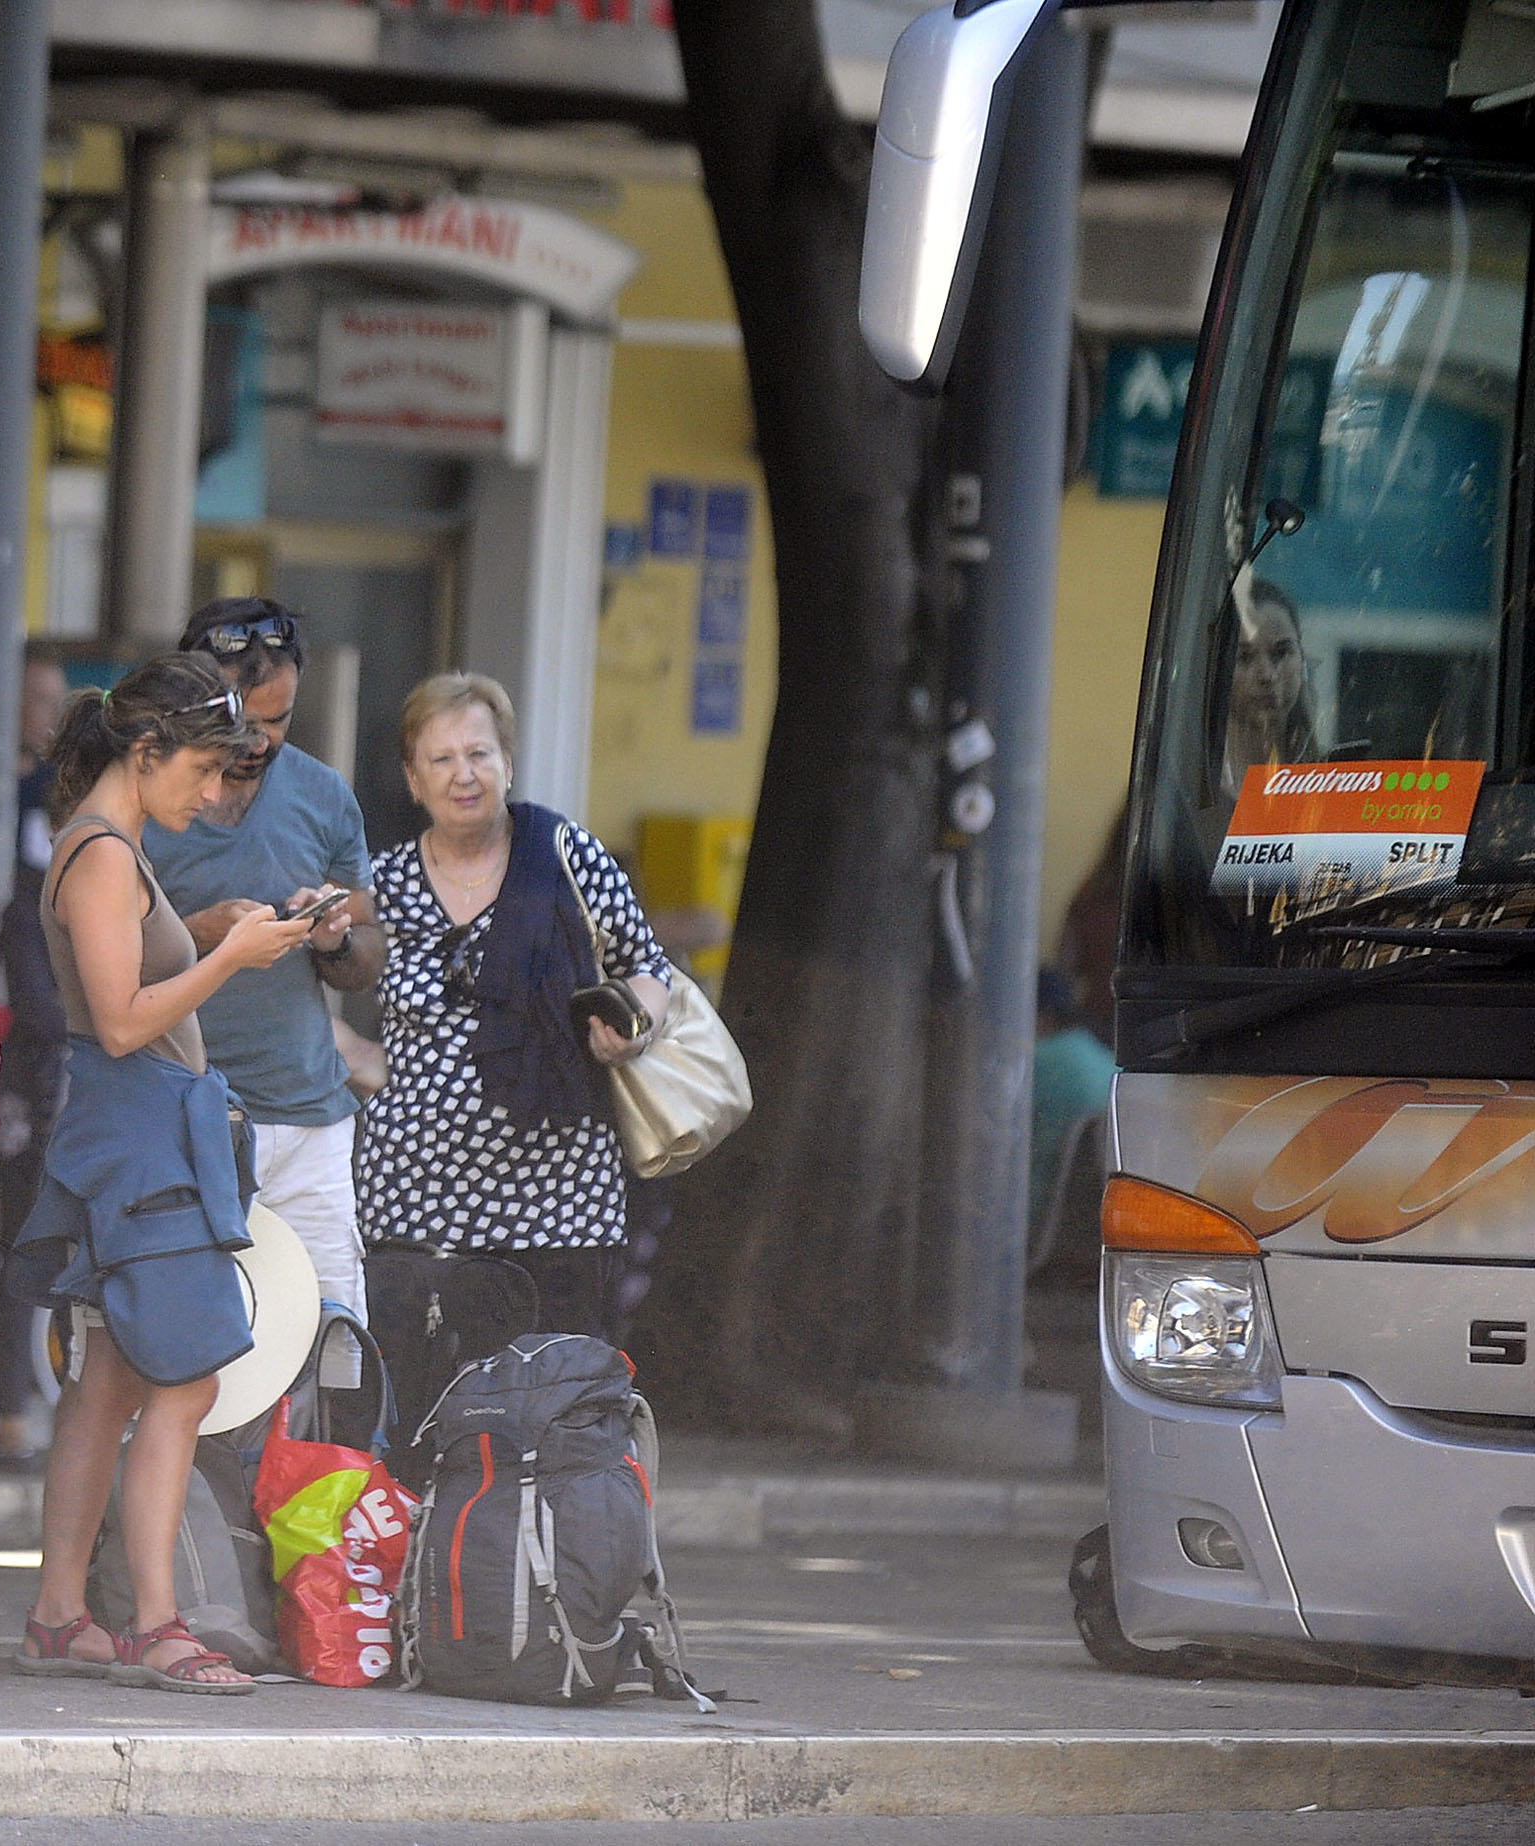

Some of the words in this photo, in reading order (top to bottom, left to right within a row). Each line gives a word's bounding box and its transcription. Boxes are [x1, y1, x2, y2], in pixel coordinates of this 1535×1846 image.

[1361, 798, 1385, 825] by
[1388, 802, 1443, 822] arriva
[1223, 842, 1295, 866] RIJEKA
[1388, 841, 1455, 864] SPLIT
[1469, 1320, 1527, 1365] S
